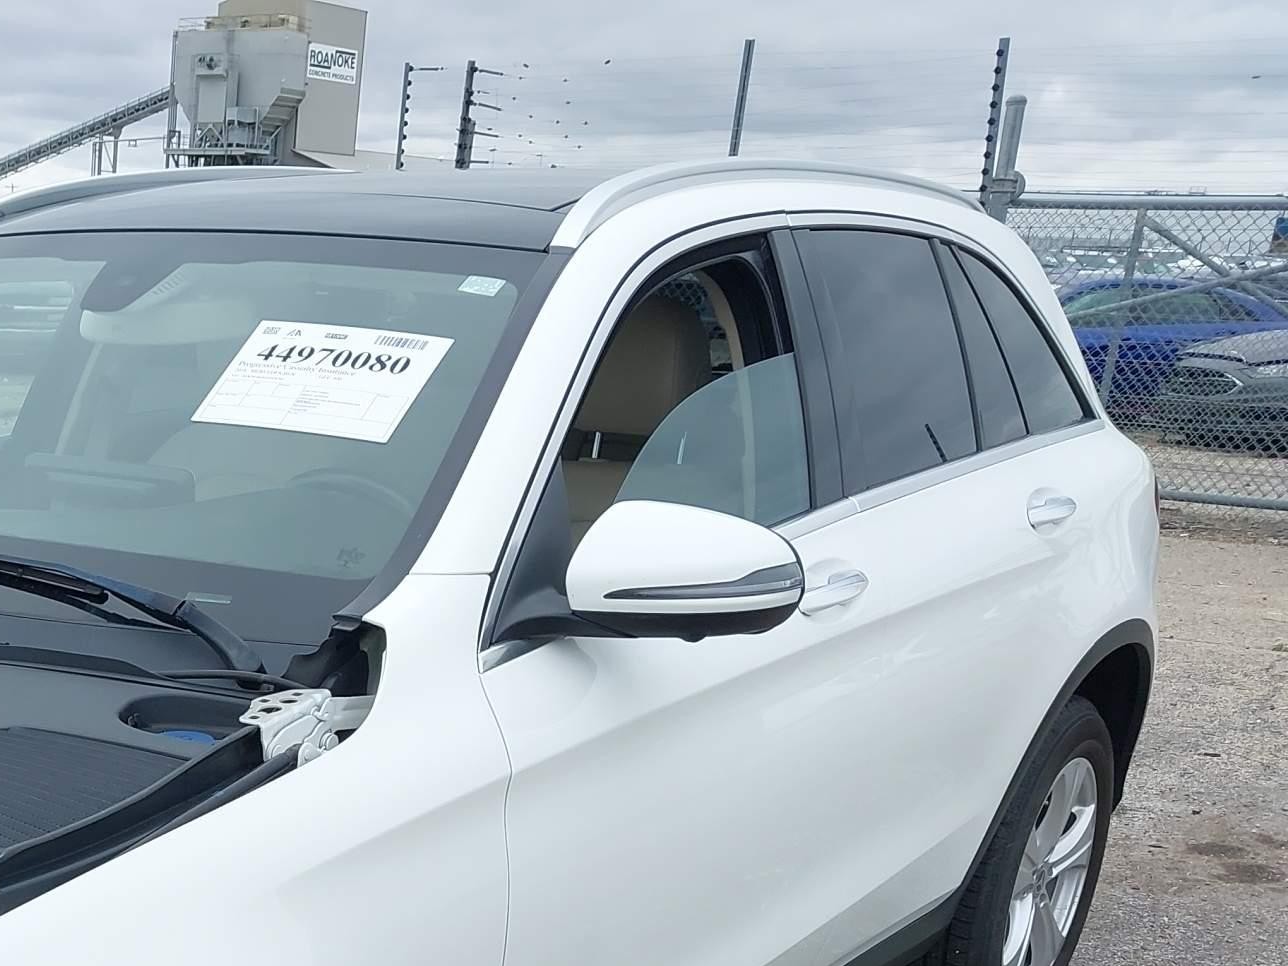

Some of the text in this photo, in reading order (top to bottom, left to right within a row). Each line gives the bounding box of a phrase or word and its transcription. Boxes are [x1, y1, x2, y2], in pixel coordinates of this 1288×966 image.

[310, 49, 356, 70] ROANOKE
[309, 69, 354, 82] CONCRETE PRODUCTS
[256, 343, 411, 375] 44970080
